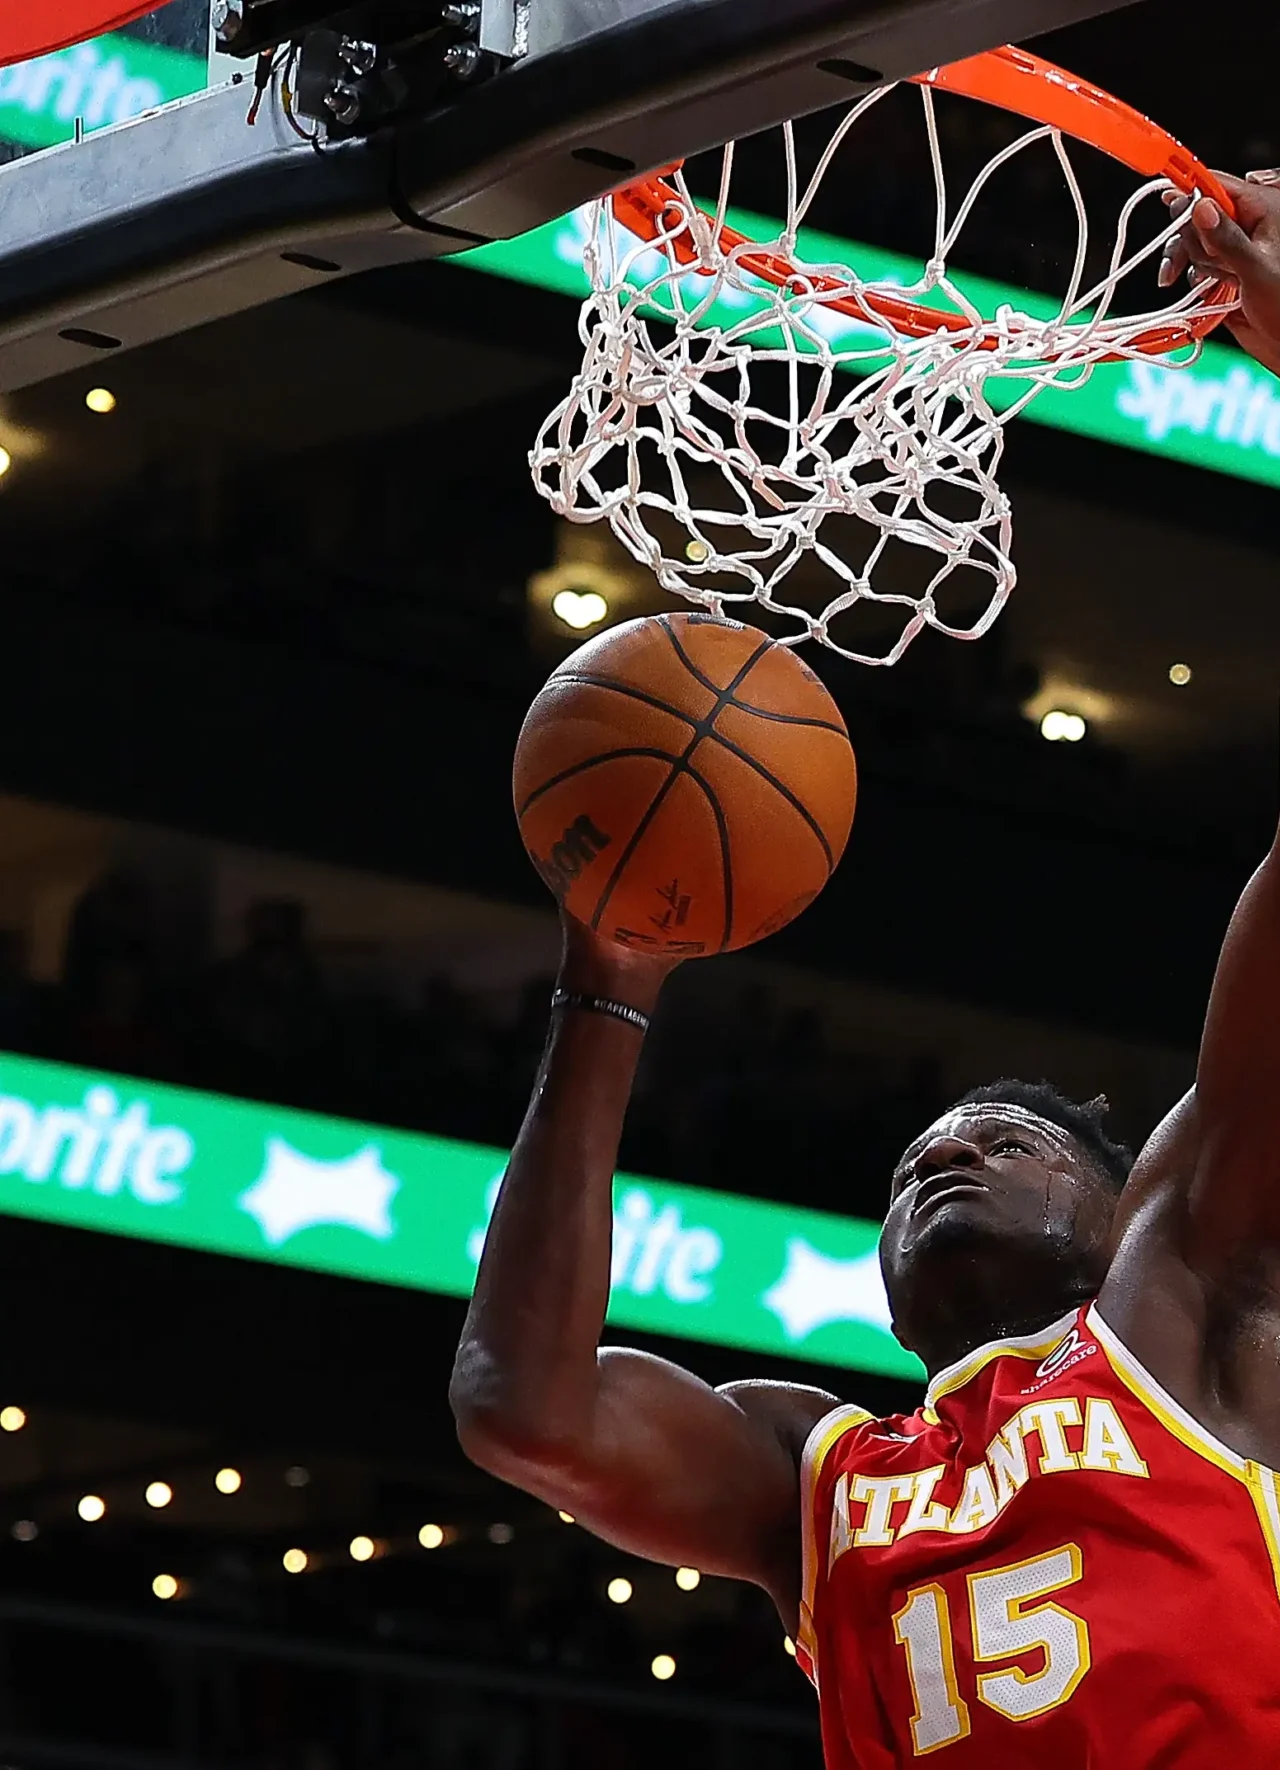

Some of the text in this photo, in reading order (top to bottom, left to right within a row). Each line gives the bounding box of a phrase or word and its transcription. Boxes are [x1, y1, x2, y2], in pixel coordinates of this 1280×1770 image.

[1020, 1345, 1098, 1395] sharecare
[828, 1397, 1150, 1582] ATLANTA
[892, 1542, 1092, 1756] 15
